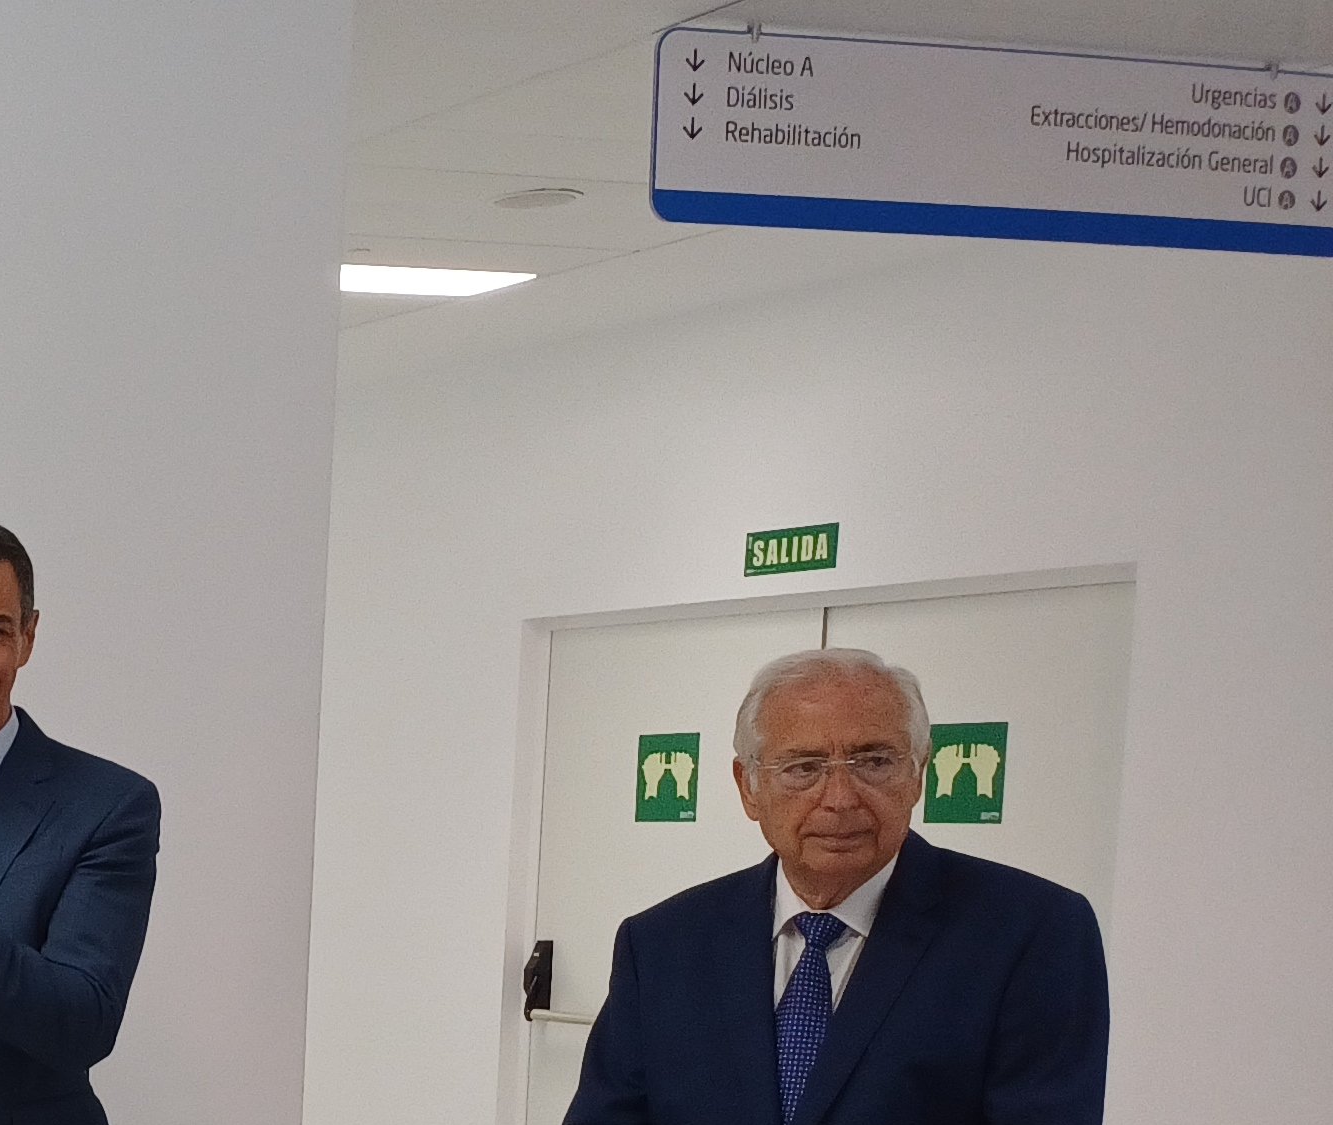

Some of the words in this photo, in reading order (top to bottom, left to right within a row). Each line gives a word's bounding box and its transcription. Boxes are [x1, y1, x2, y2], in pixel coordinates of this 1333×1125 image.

[727, 51, 795, 77] Núcleo
[799, 56, 814, 77] A
[726, 85, 794, 111] Diálisis
[1191, 83, 1277, 110] Urgencias
[724, 120, 861, 149] Rehabilitación
[1030, 105, 1148, 133] Extracciones/
[1150, 113, 1276, 142] Hemodonación
[1065, 141, 1202, 170] Hospitalización
[1207, 151, 1275, 175] General
[1243, 186, 1272, 208] UCI
[752, 533, 828, 567] SALIDA
